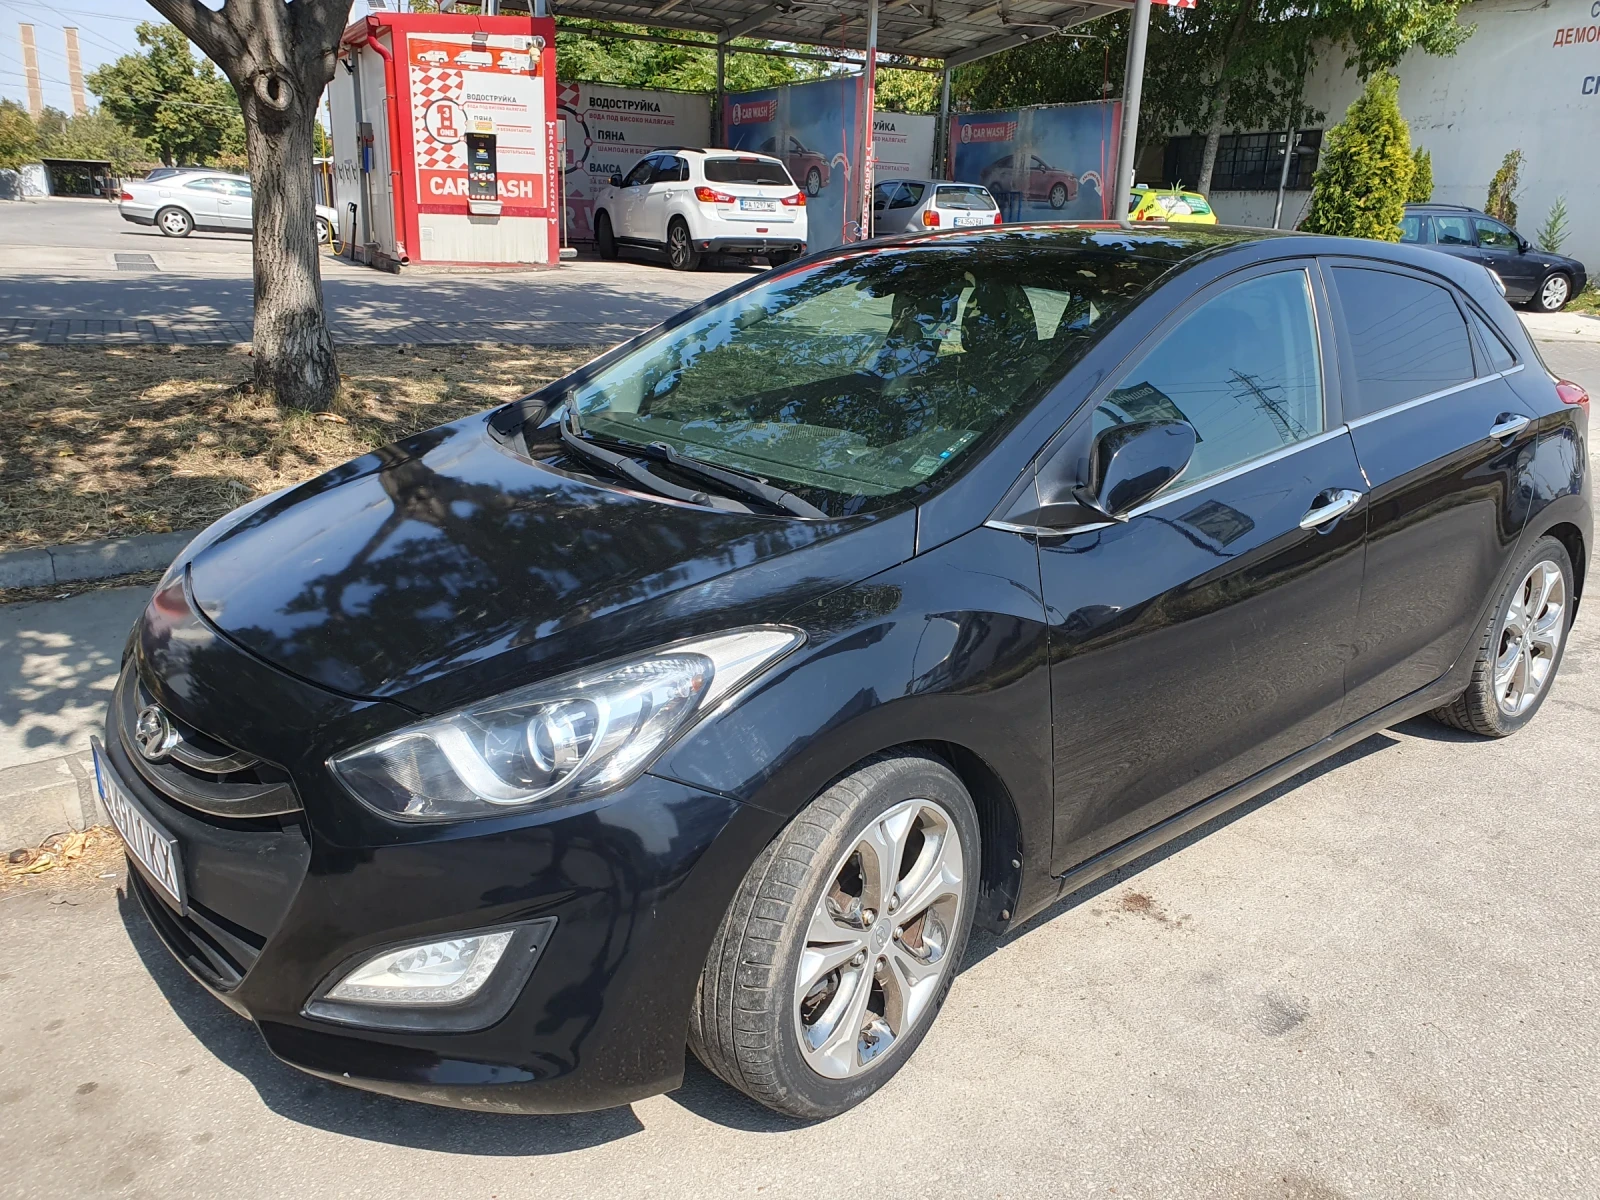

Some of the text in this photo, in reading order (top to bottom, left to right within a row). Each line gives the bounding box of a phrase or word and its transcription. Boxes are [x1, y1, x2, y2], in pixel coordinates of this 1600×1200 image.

[466, 93, 517, 103] ВОДОСТРУЙКА
[589, 96, 661, 112] ВОДОСТРУЙКА
[443, 108, 450, 118] 3
[742, 108, 752, 119] CAR
[753, 106, 768, 118] WASH
[644, 117, 675, 126] НАЛЯГАНЕ
[597, 129, 625, 141] ПЯНА
[973, 128, 985, 138] CAR
[986, 126, 1005, 138] WASH
[597, 145, 629, 153] ШАМПОАН
[548, 129, 556, 213] ПРАХОСМУКАЧКА
[589, 162, 622, 173] ВАКСА
[429, 177, 533, 198] CAR ASH
